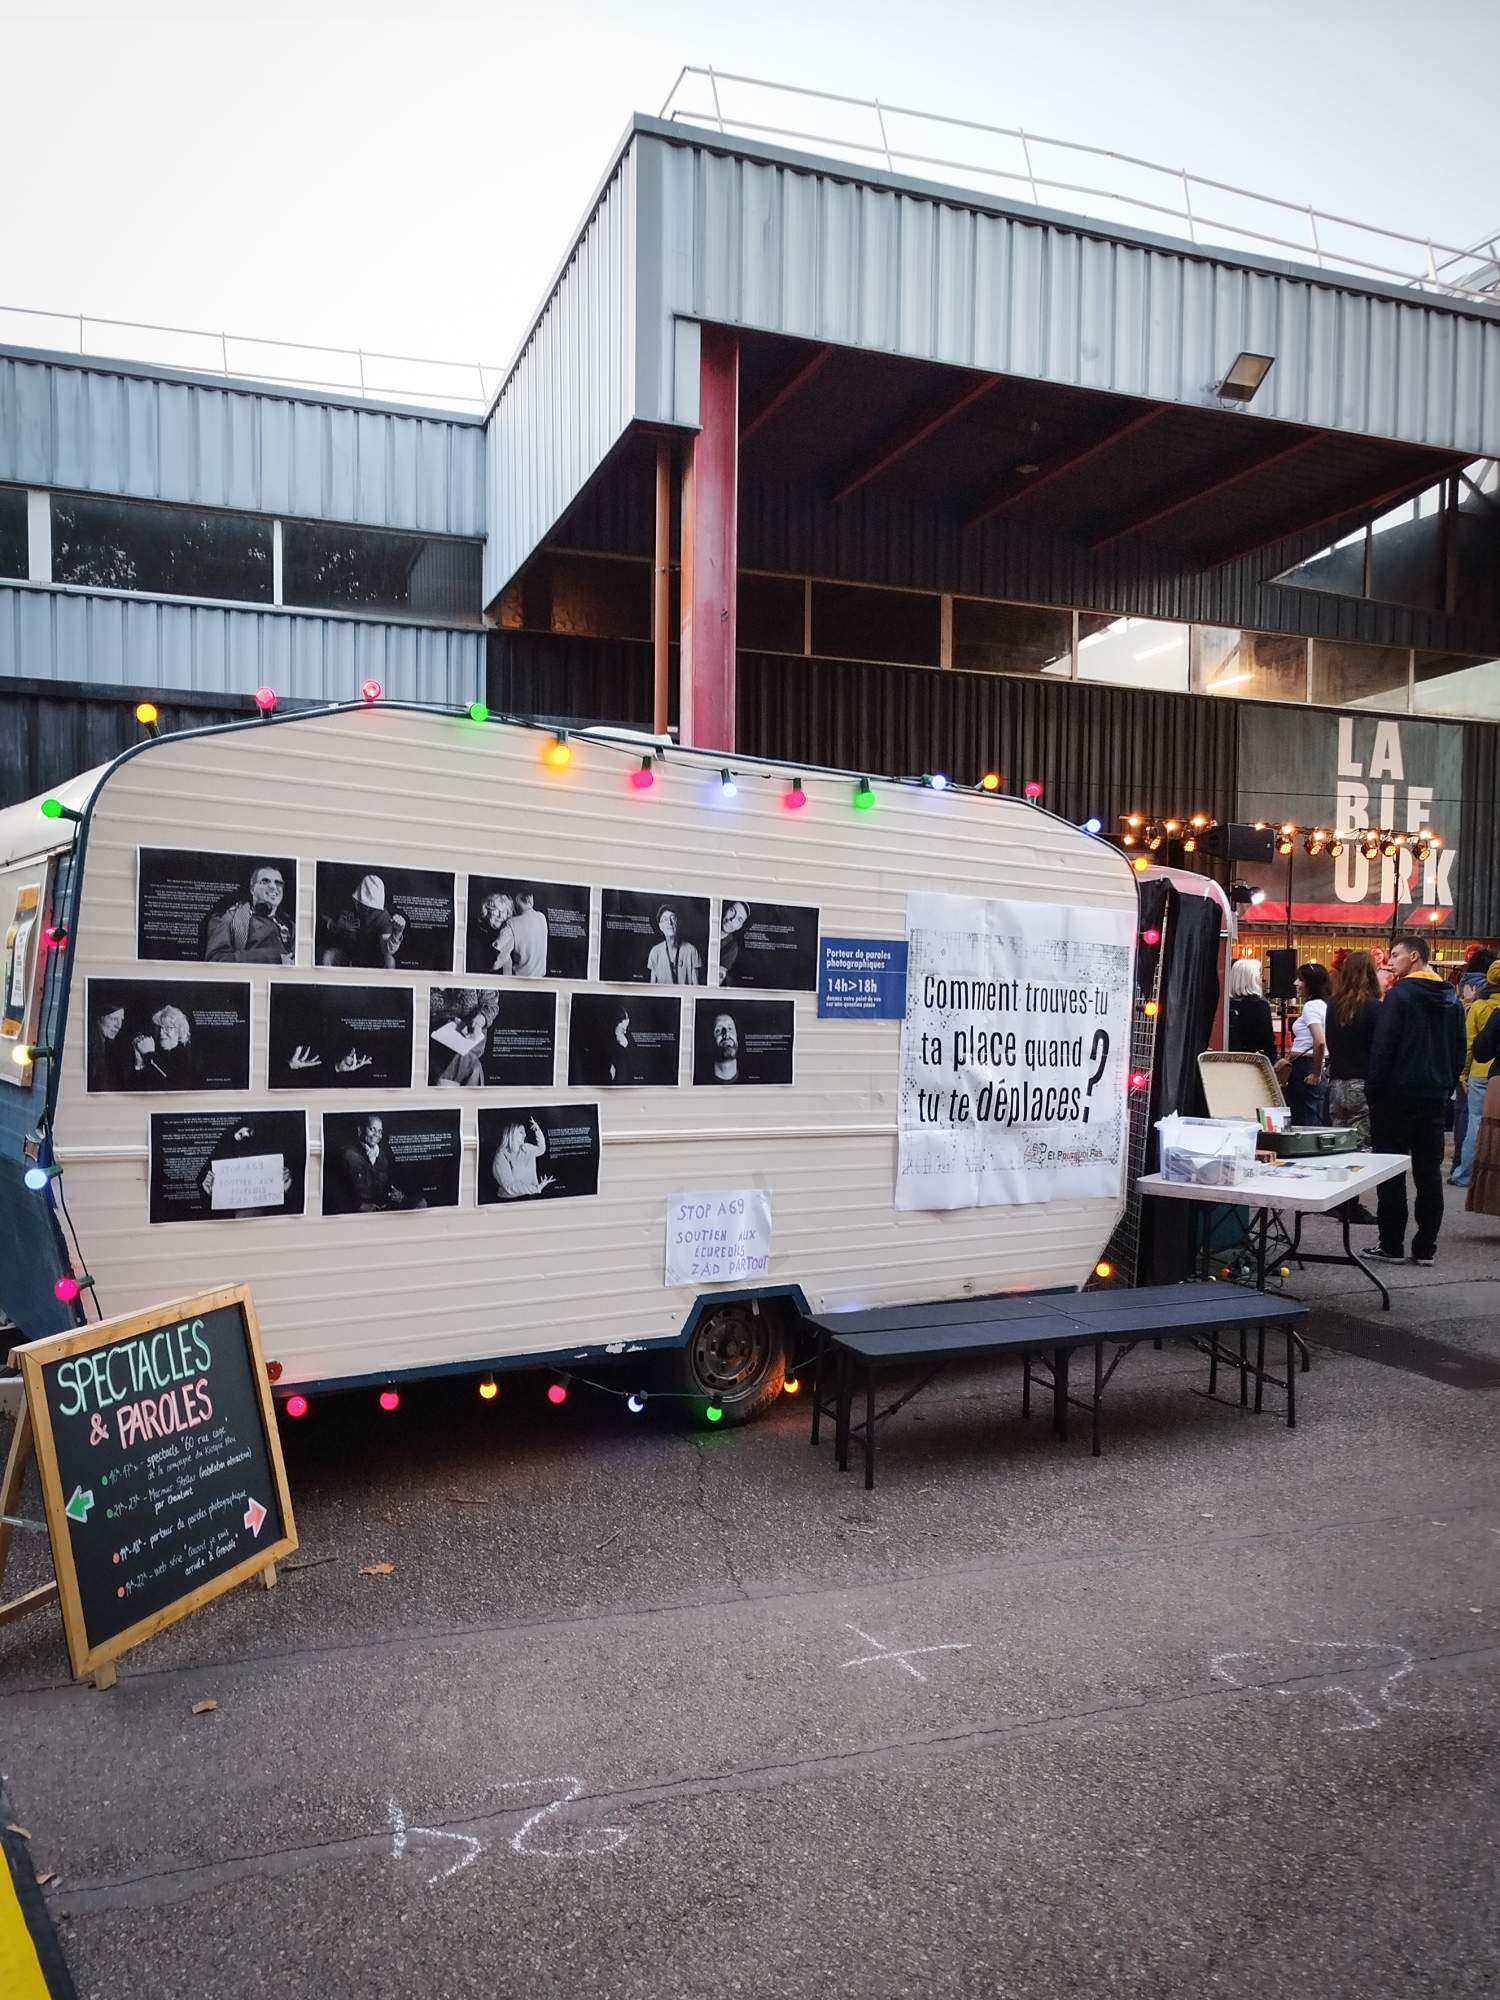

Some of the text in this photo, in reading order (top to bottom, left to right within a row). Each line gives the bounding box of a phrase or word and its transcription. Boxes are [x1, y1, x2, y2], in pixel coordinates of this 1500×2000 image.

[1337, 717, 1404, 780] LA
[1334, 844, 1457, 906] URK
[826, 947, 891, 961] Porteur de paroles
[826, 957, 885, 970] photographiques
[827, 978, 877, 993] 14h>18h
[923, 976, 1109, 1016] Comment trouves-tu
[921, 1025, 1082, 1072] ta place quand
[918, 1088, 939, 1123] tu
[949, 1090, 969, 1123] te
[677, 1198, 745, 1221] STOP A69
[738, 1229, 757, 1242] AUX
[691, 1263, 720, 1277] ZAD
[57, 1319, 212, 1416] SPECTACLES
[90, 1378, 214, 1449] & PAROLES
[146, 1443, 180, 1469] spectacle
[154, 1500, 164, 1516] par
[150, 1524, 174, 1550] porteur
